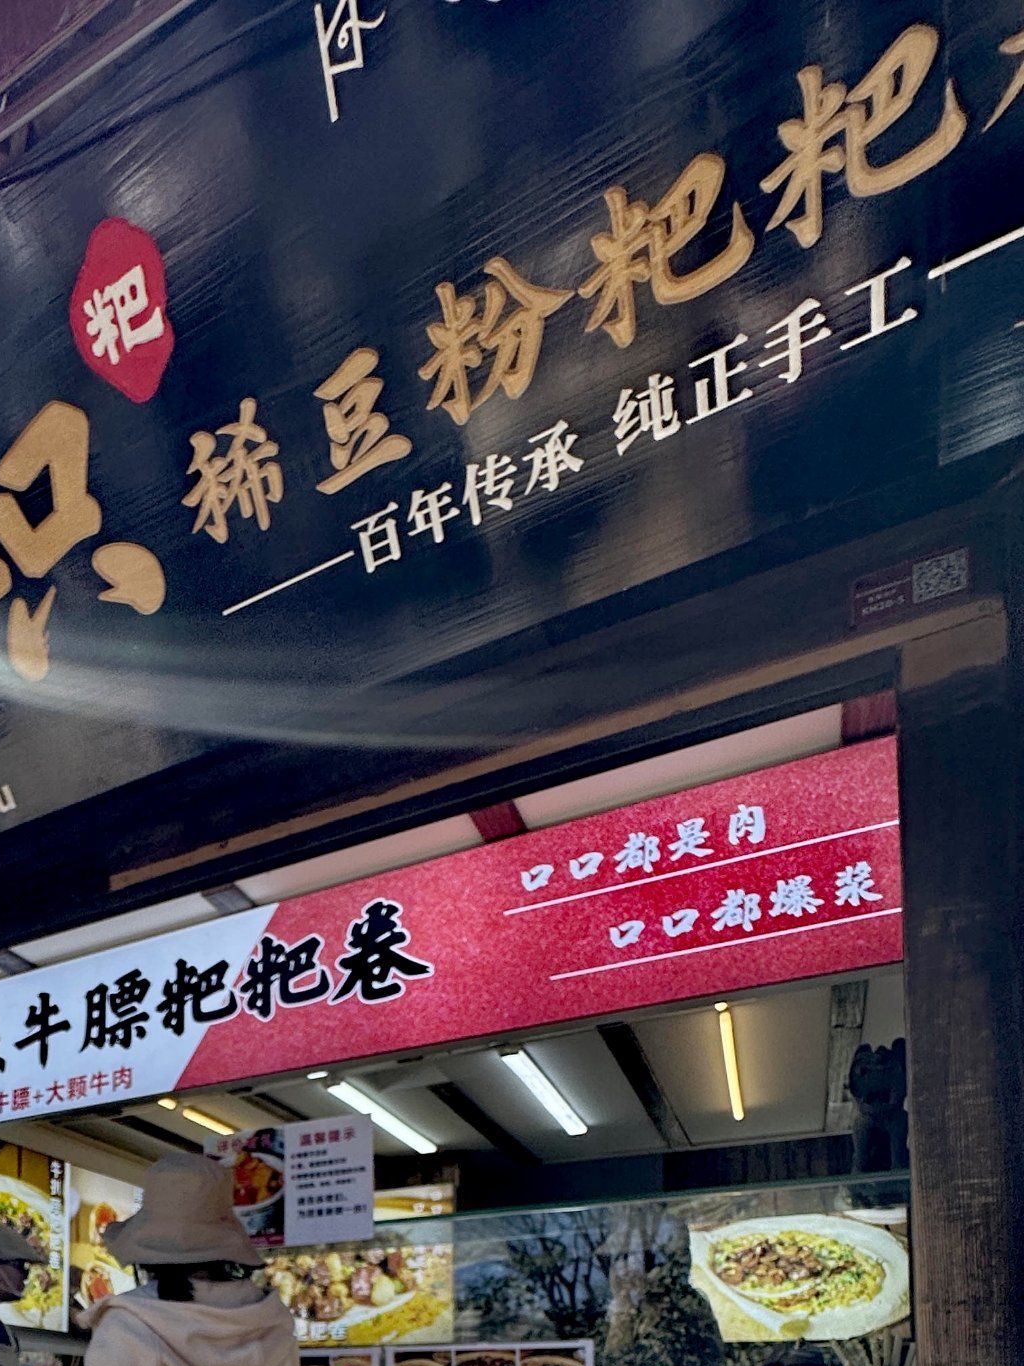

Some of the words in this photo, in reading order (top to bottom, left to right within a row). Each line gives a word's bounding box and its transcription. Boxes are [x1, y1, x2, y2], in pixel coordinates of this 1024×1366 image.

[82, 264, 165, 365] 粑
[180, 24, 1024, 543] 稀豆粉粑粑
[350, 419, 584, 574] 百年传承
[612, 256, 918, 457] 纯正手工
[520, 803, 767, 892] 口口都是肉
[609, 860, 884, 949] 口口都爆浆
